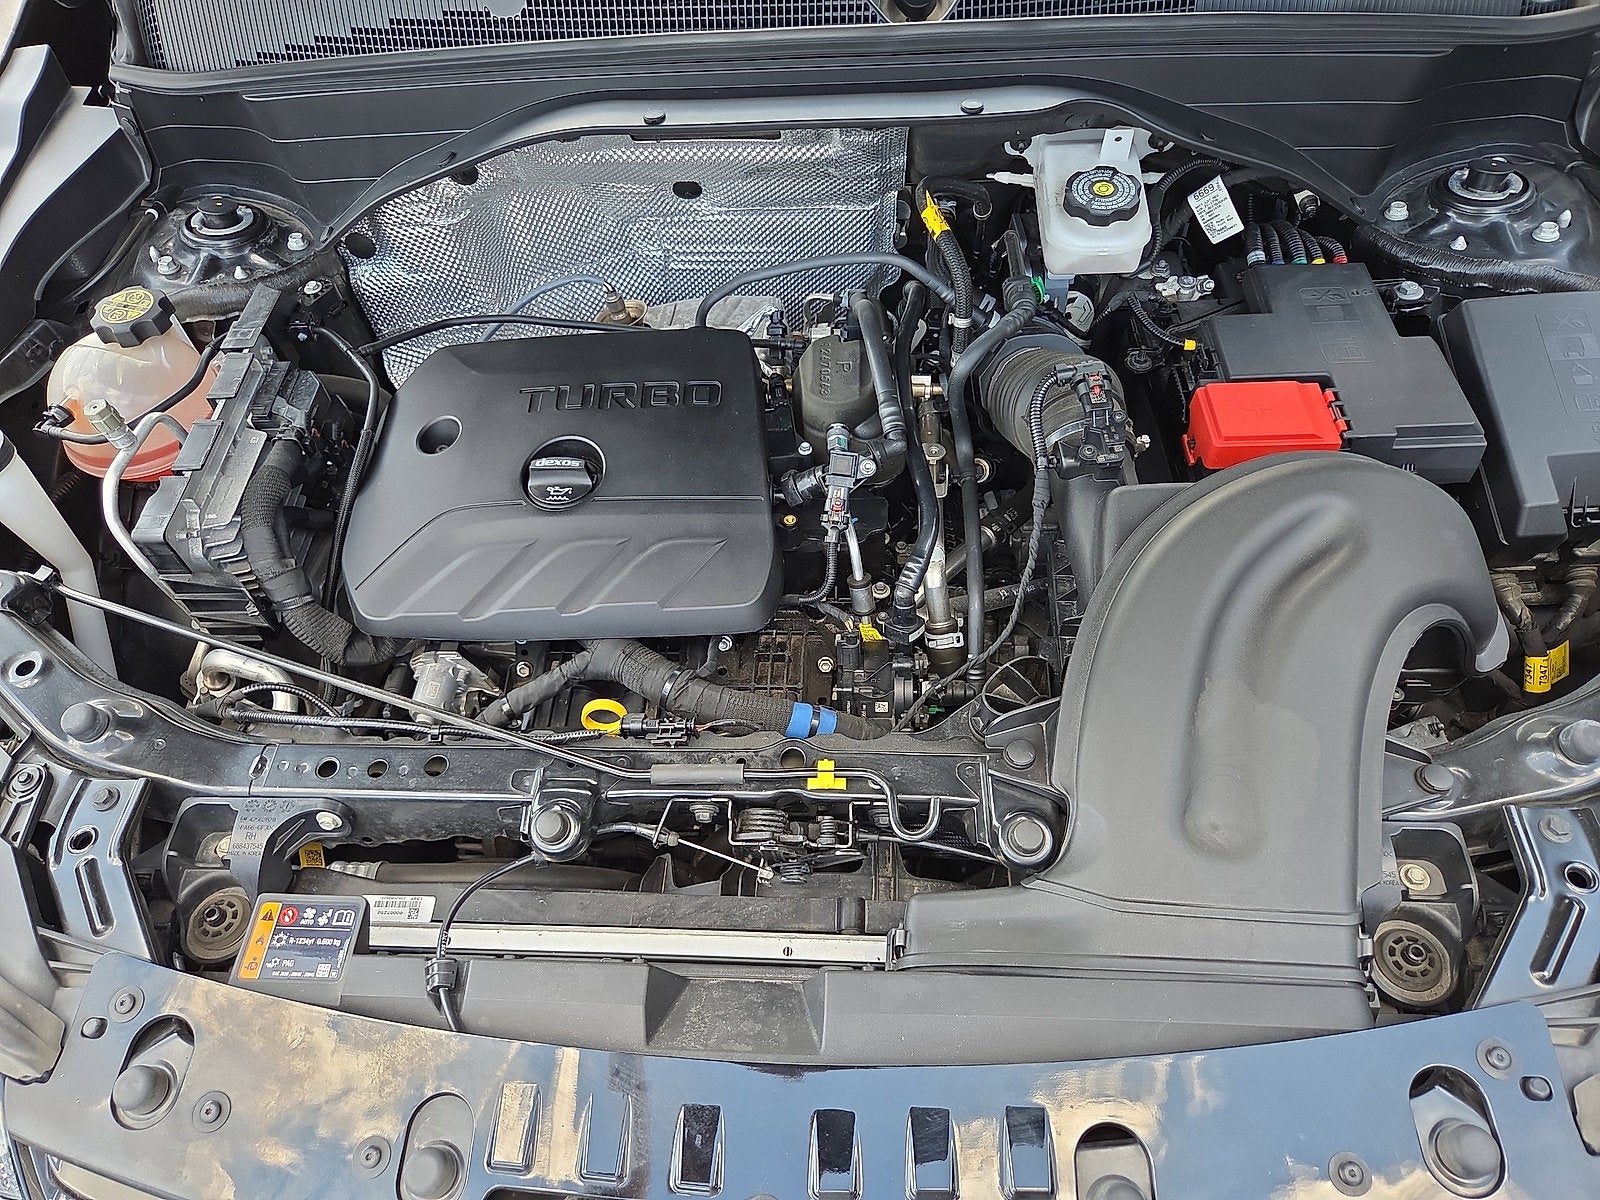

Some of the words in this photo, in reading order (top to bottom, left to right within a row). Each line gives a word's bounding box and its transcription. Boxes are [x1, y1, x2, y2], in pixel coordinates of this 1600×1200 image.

[1193, 183, 1215, 200] 6669
[519, 380, 722, 412] TURBO
[535, 458, 582, 467] dexos
[1539, 665, 1548, 686] 7347
[245, 832, 256, 840] RH
[289, 937, 315, 948] R-1234yf
[332, 938, 342, 947] kg
[281, 959, 295, 968] PAG
